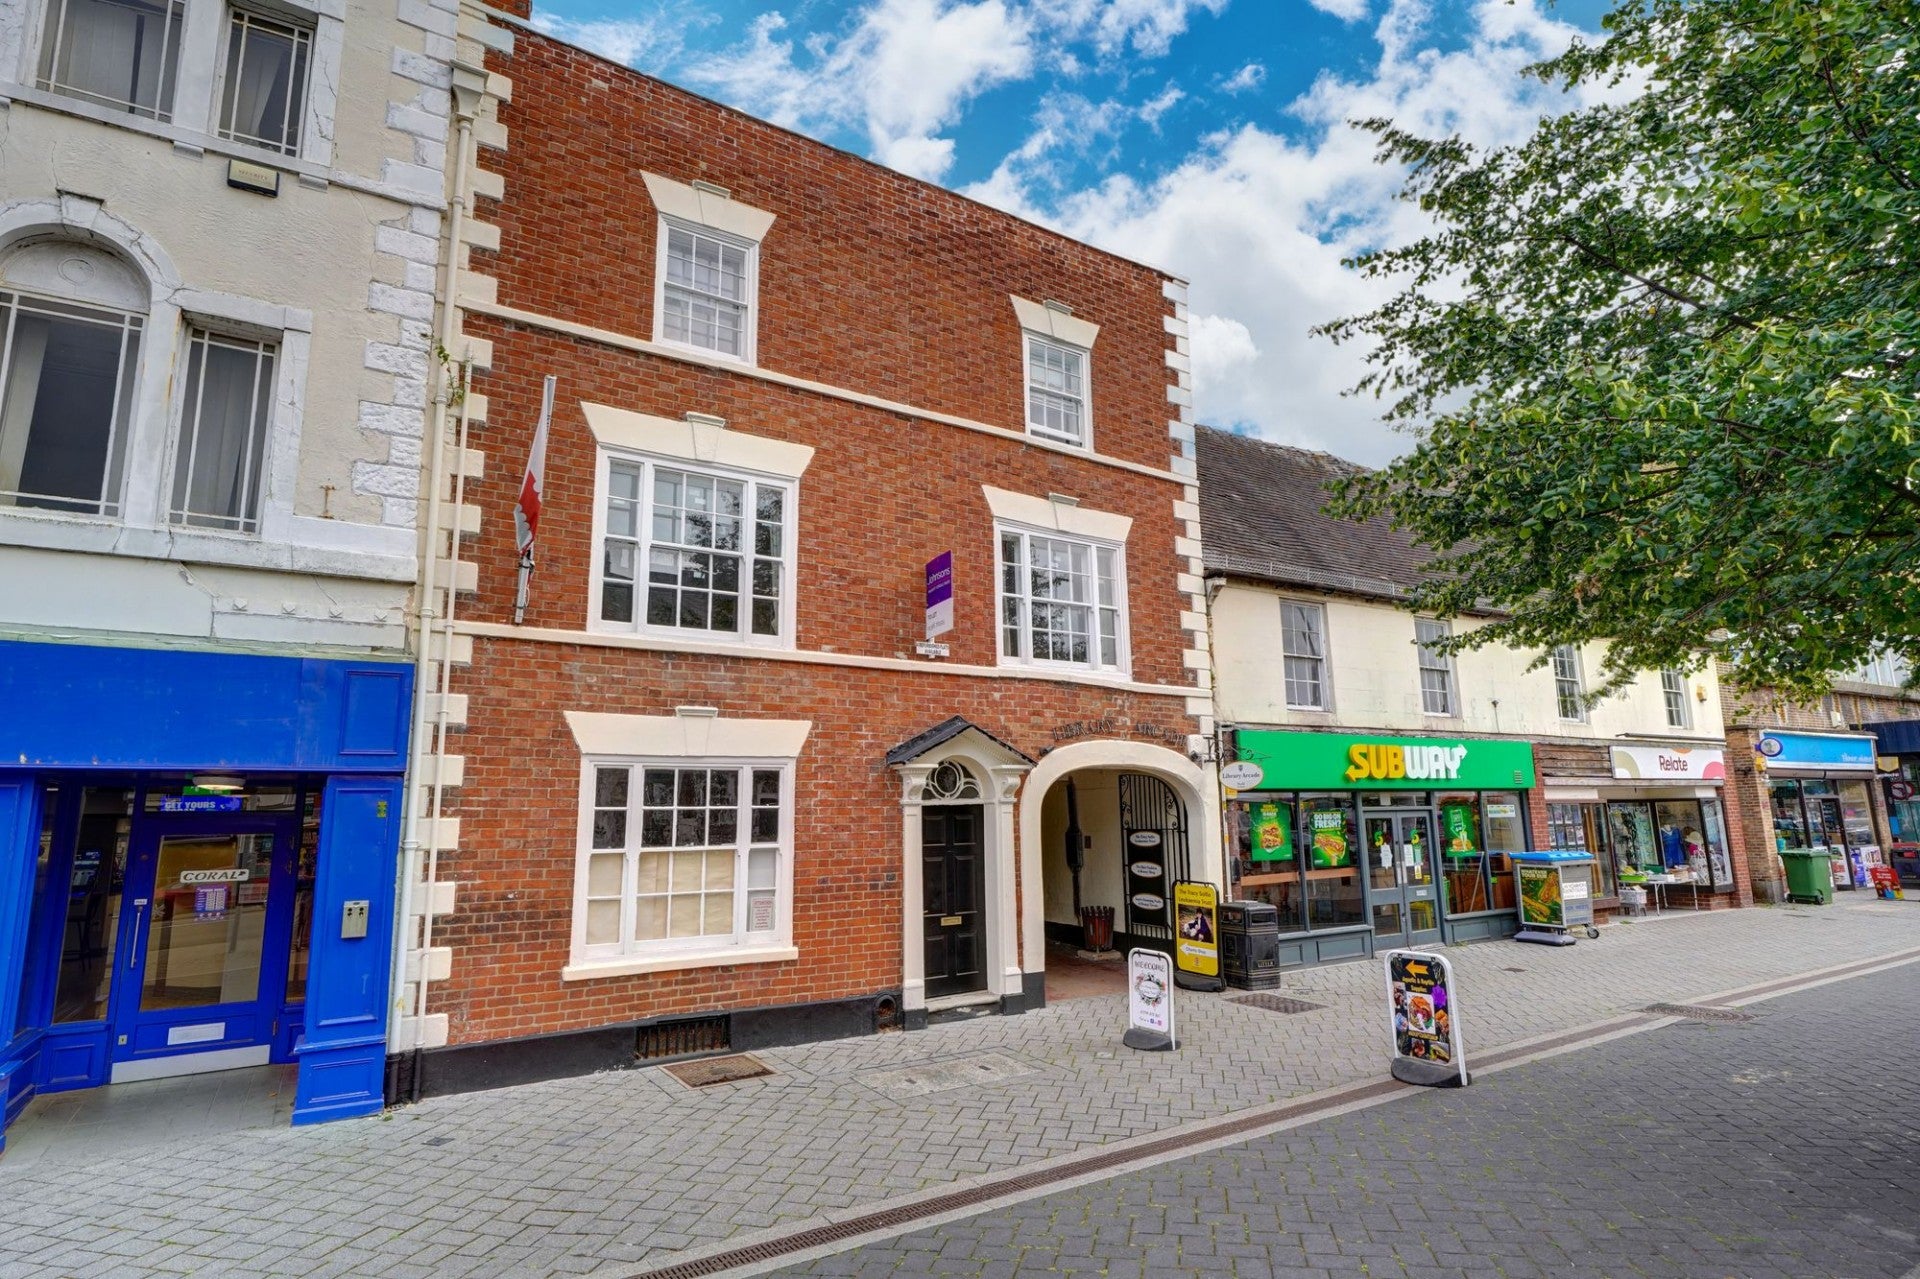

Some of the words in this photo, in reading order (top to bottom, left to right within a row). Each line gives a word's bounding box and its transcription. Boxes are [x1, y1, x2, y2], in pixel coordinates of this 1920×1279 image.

[927, 568, 951, 585] Johnsons
[1052, 719, 1114, 740] LIBRARY
[1345, 744, 1468, 782] SUBWAY
[1659, 755, 1688, 771] Relate
[165, 801, 182, 809] GET
[185, 801, 216, 809] YOURS
[1314, 819, 1341, 829] FRESH?
[183, 871, 238, 881] CORAL
[1134, 961, 1165, 972] WELCOME
